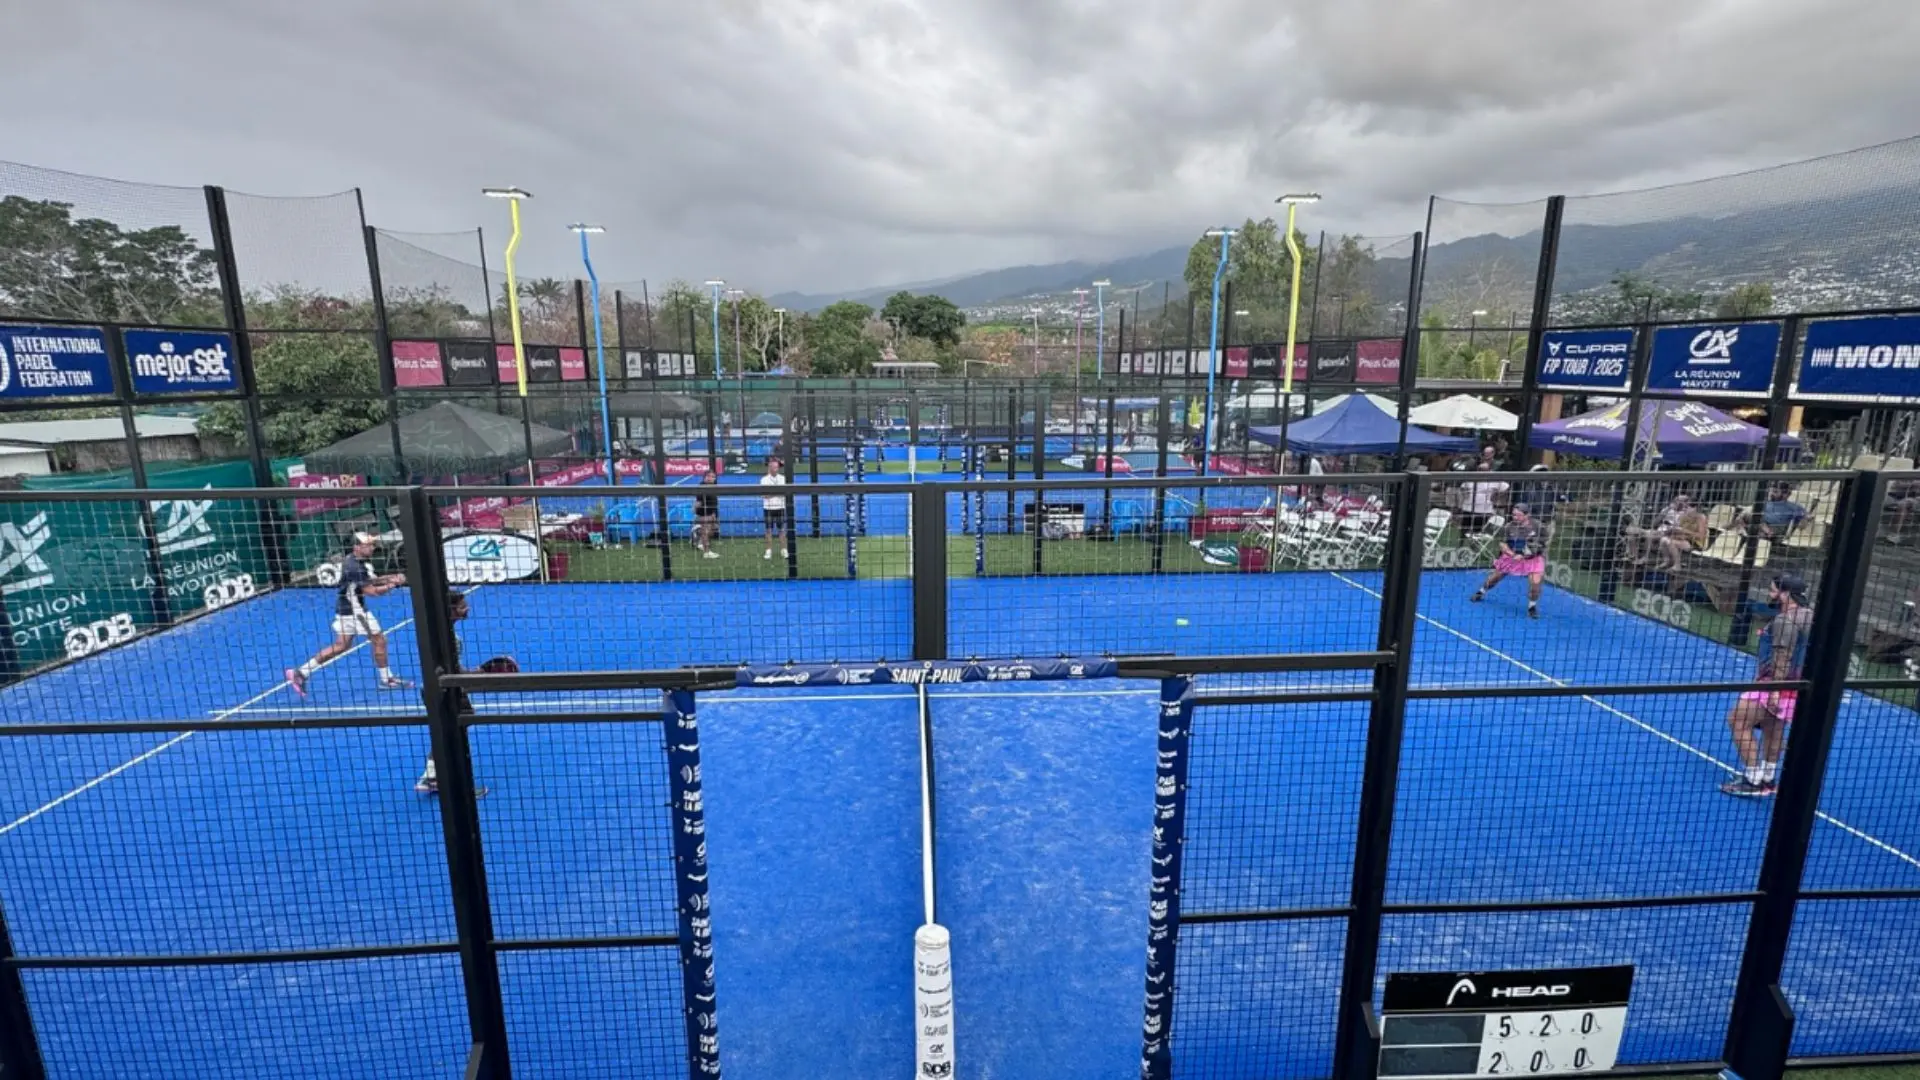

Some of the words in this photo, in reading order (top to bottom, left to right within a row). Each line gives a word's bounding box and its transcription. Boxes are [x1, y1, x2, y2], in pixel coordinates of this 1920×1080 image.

[12, 335, 104, 353] INTERNATIONAL
[1566, 344, 1627, 355] CUPRA
[15, 354, 57, 370] PADEL
[1543, 358, 1561, 375] FIP
[1561, 358, 1589, 376] TOUR
[1594, 358, 1624, 377] 2025
[20, 371, 93, 388] FEDERATION
[1674, 369, 1688, 379] LA
[1689, 368, 1741, 380] RÉUNION
[1681, 379, 1730, 389] MAYOTTE
[130, 573, 157, 591] LA
[168, 568, 230, 599] AYOTTE
[8, 590, 89, 627] UNION
[13, 616, 73, 648] OTTE
[890, 667, 964, 684] SAINT-PAUL
[1491, 984, 1571, 998] HEAD
[1498, 1015, 1511, 1038] 5
[1538, 1014, 1553, 1037] 2
[1580, 1012, 1593, 1035] 0
[1487, 1052, 1502, 1074] 2
[1529, 1050, 1543, 1073] 0
[1574, 1047, 1587, 1069] 0
